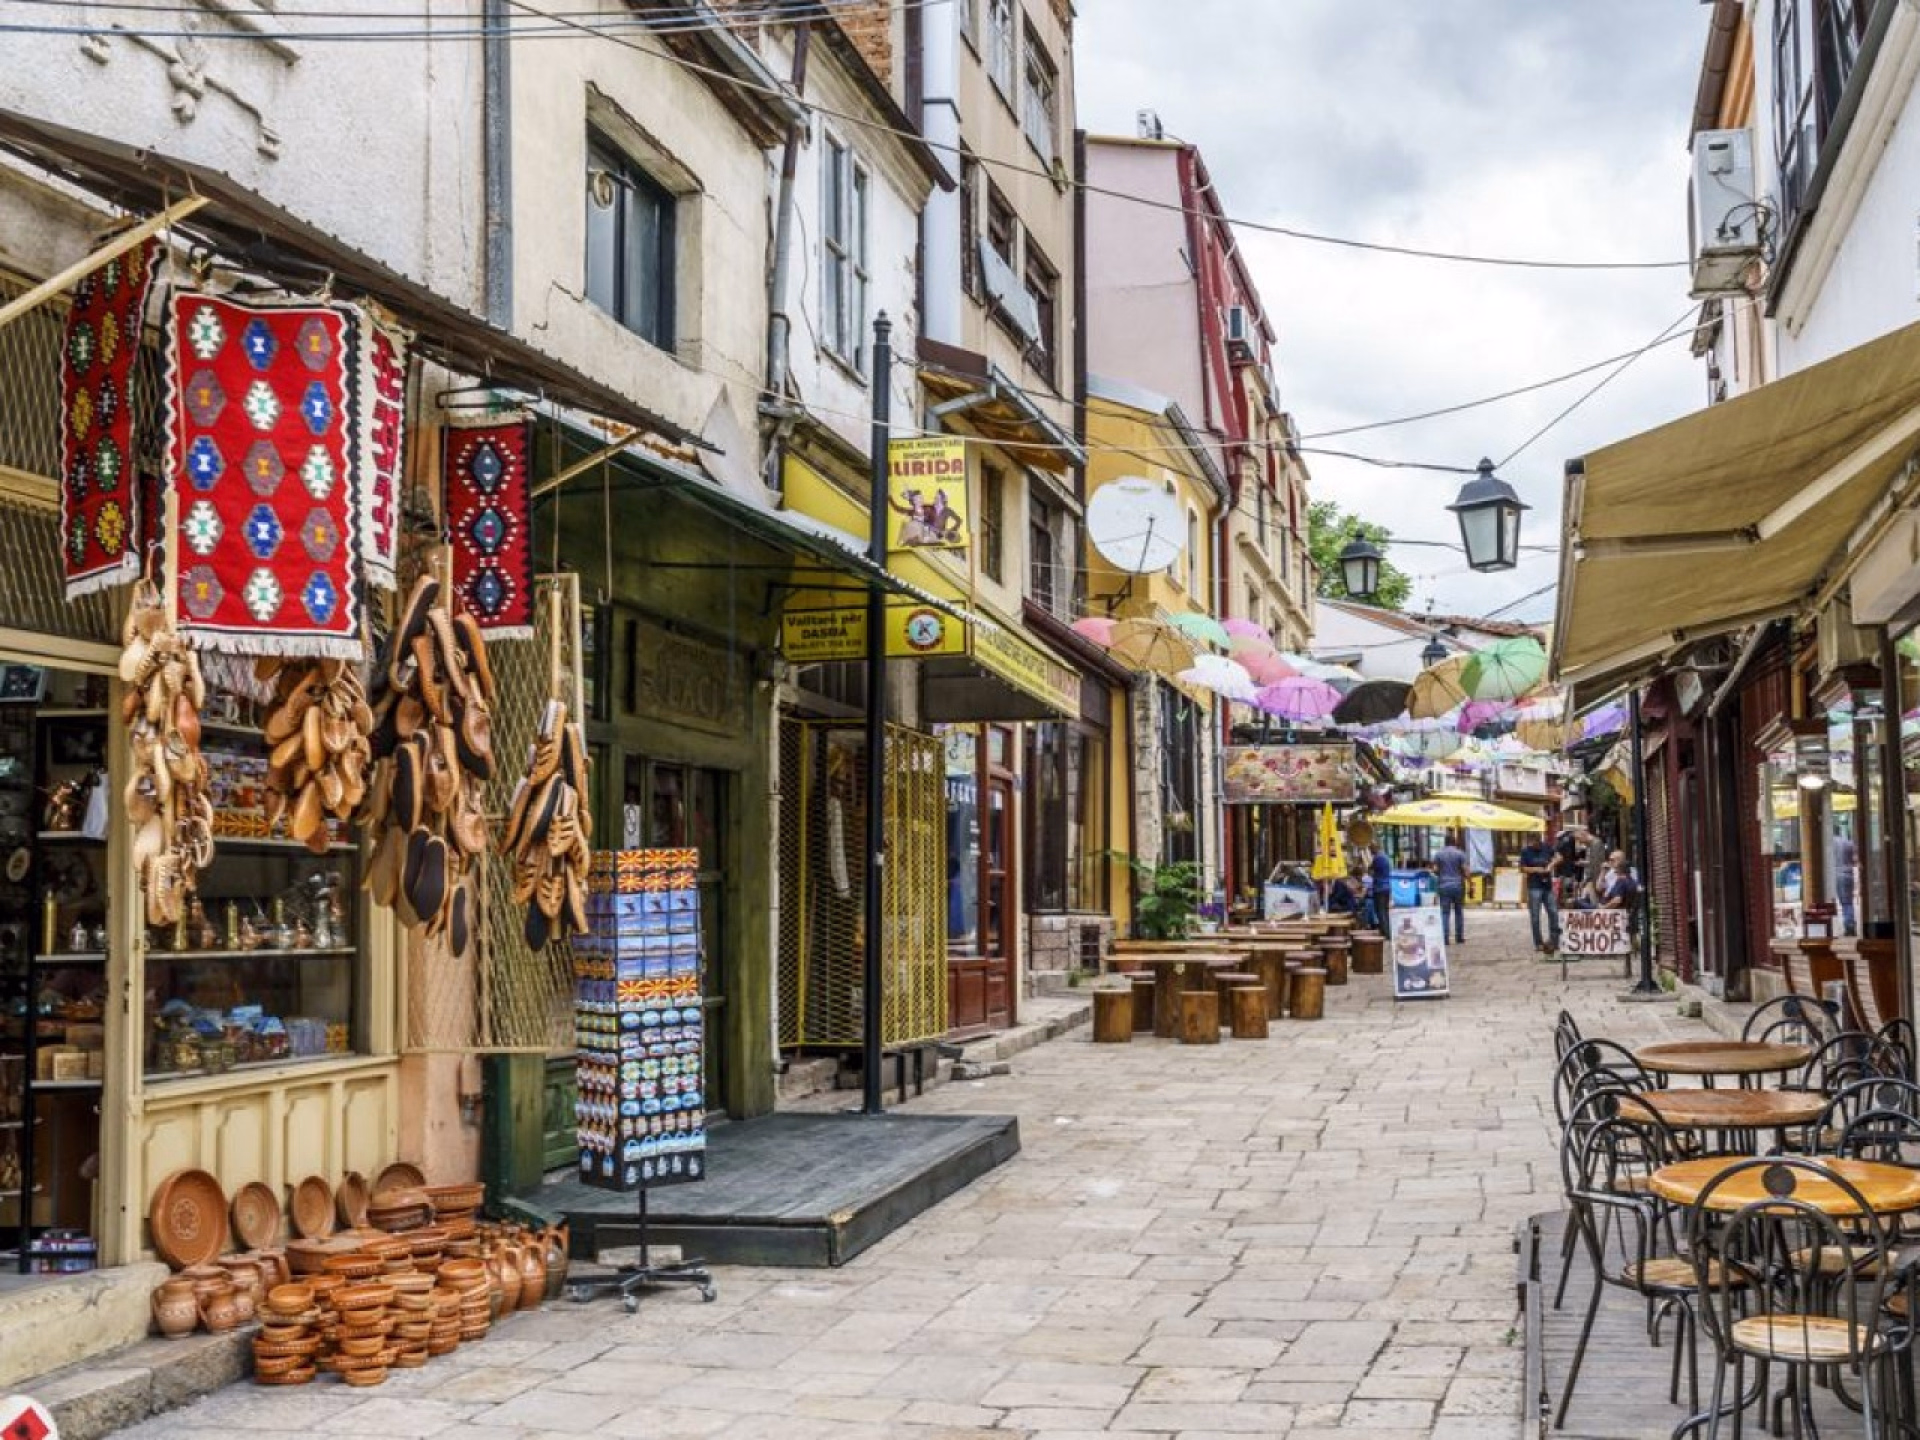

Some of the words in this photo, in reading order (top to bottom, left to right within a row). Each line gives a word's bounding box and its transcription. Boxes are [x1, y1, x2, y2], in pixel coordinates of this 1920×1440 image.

[801, 626, 848, 640] DASMA
[1566, 911, 1621, 931] ANTIQUE
[1568, 932, 1623, 952] SHOP
